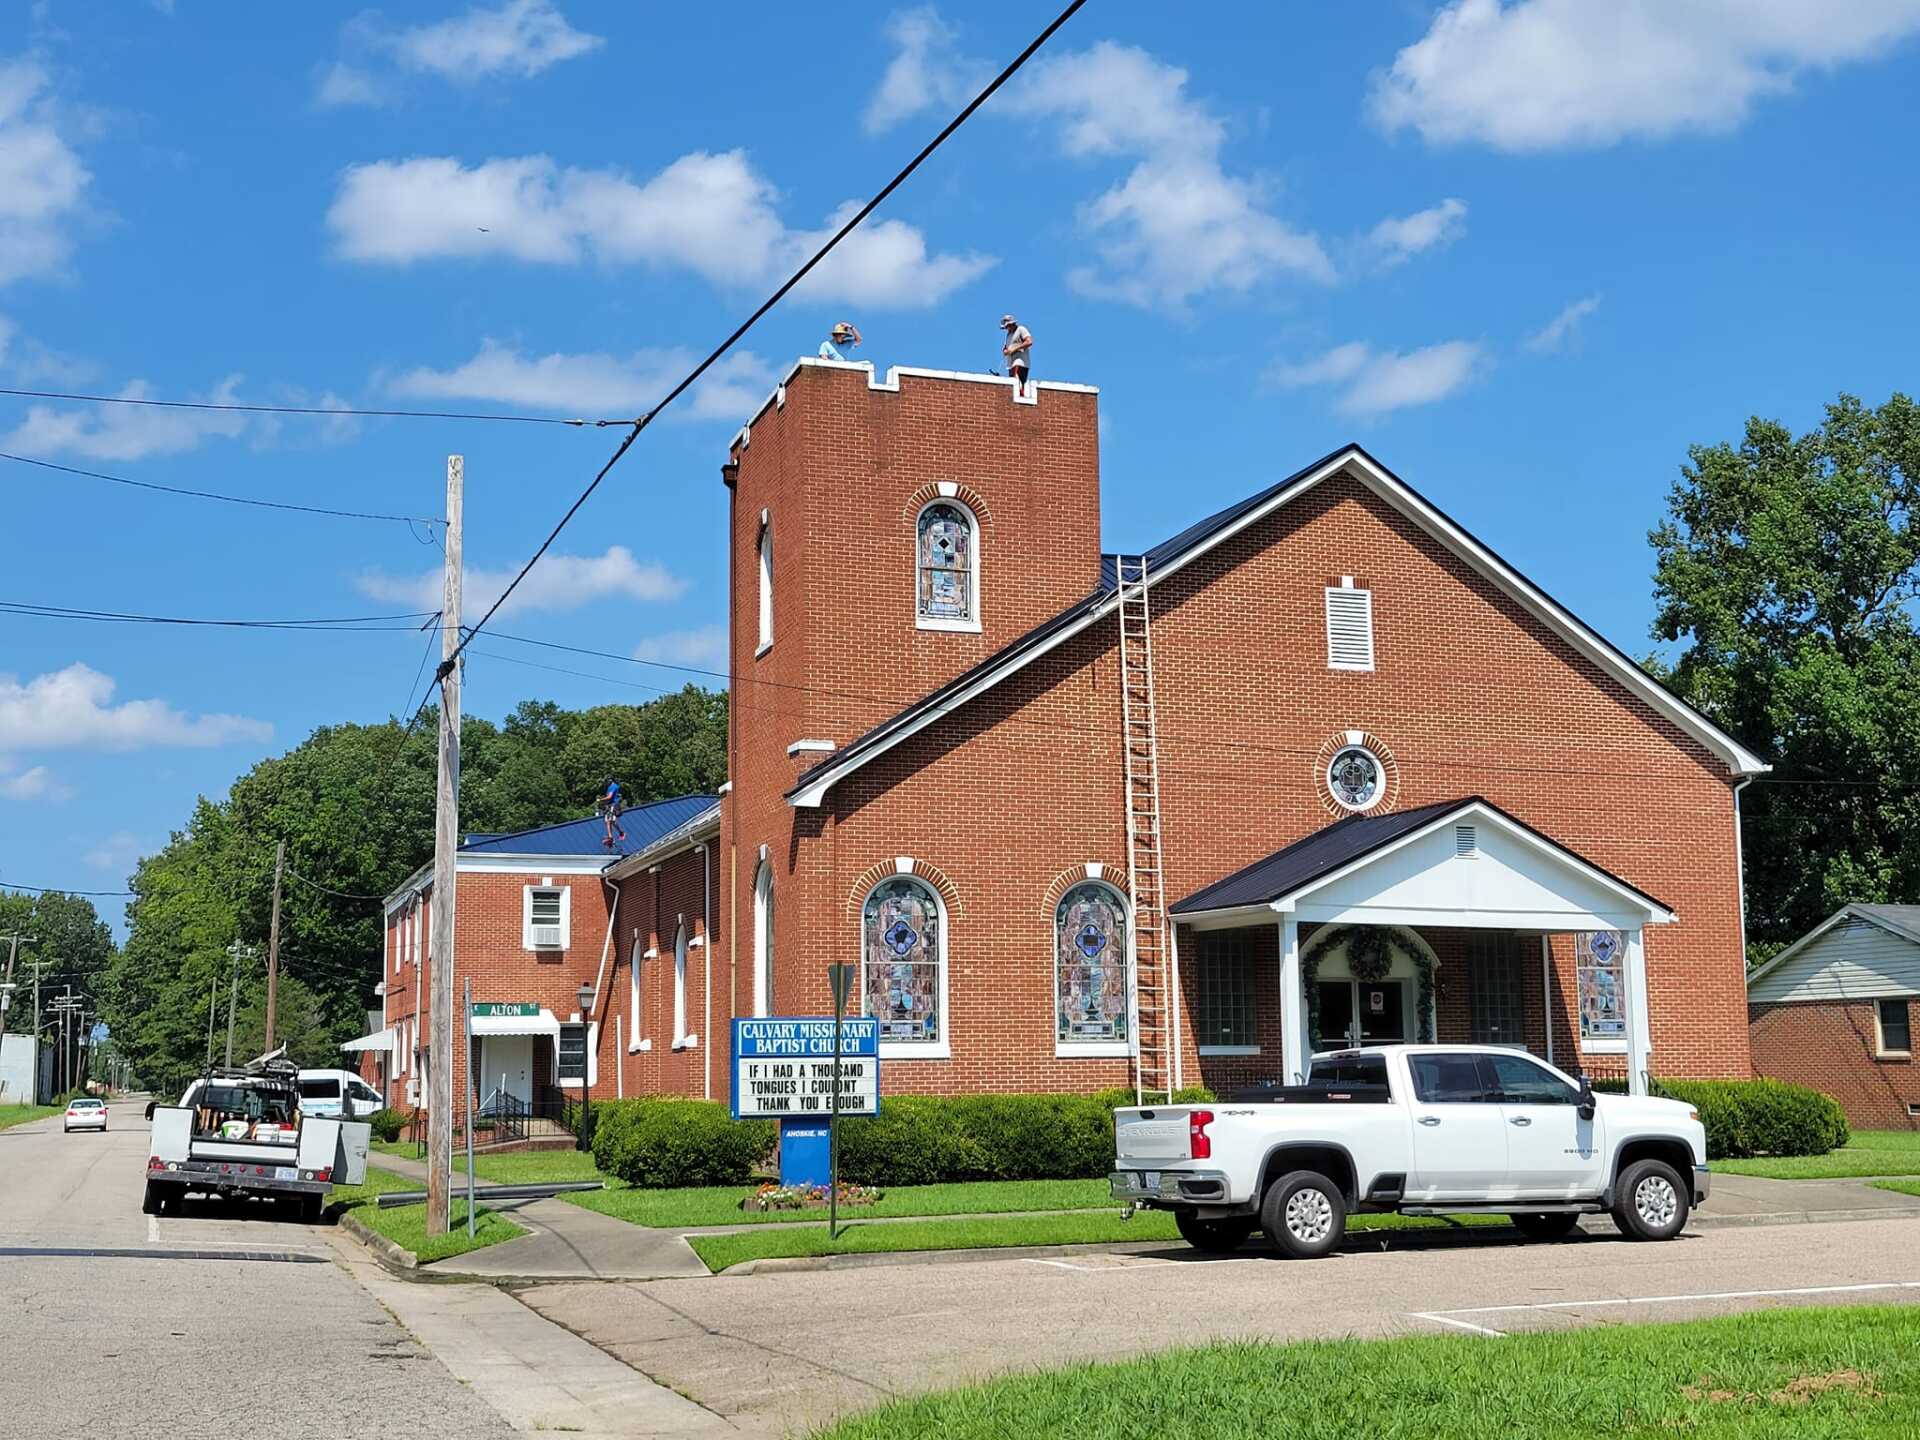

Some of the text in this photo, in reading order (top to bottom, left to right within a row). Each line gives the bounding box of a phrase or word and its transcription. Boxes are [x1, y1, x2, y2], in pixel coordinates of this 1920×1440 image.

[490, 1005, 521, 1016] ALTON
[742, 1023, 797, 1039] CALVARY
[800, 1023, 873, 1038] MISSIONARY
[756, 1038, 860, 1053] BAPTIST CHURCH
[749, 1063, 863, 1078] IF I HAD A THOUSAND
[750, 1081, 797, 1094] TONGUES
[802, 1080, 806, 1094] I
[756, 1095, 865, 1111] THANK YOU EOUGH
